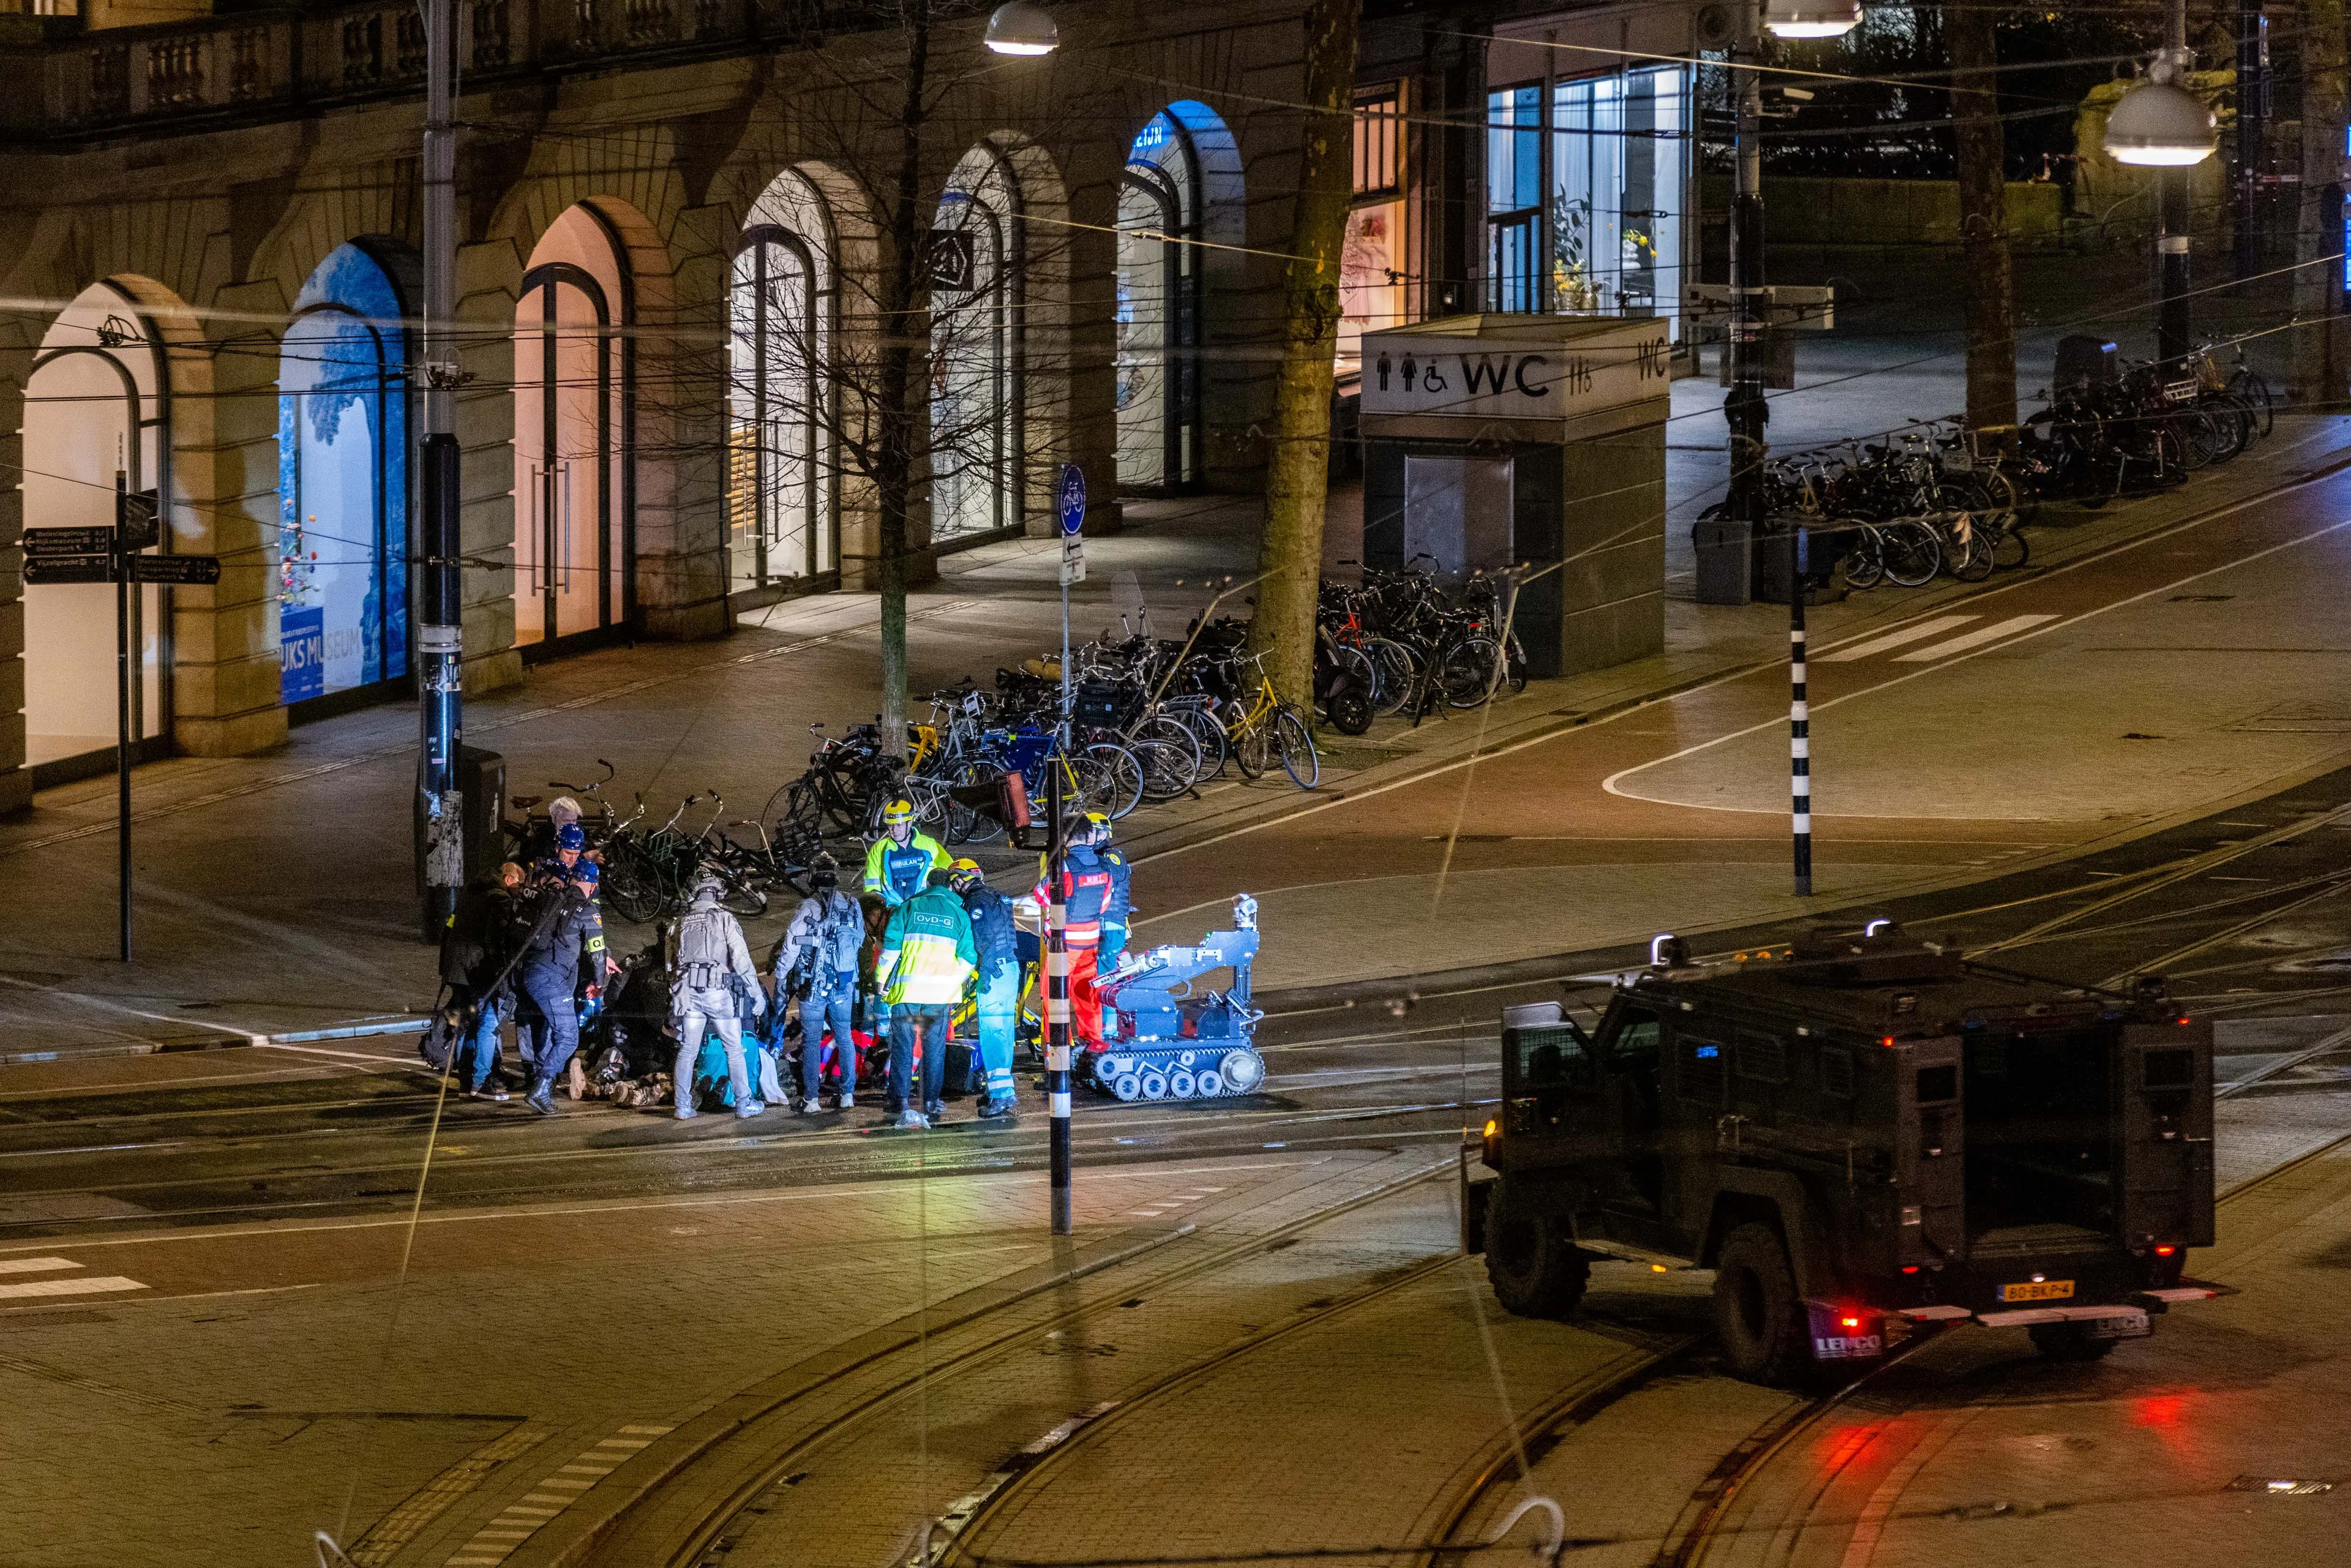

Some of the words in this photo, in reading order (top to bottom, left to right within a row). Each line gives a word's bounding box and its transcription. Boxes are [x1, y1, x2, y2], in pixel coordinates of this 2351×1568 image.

[1458, 353, 1550, 398] WC
[1638, 337, 1665, 381] WC
[917, 915, 951, 926] OvD-G
